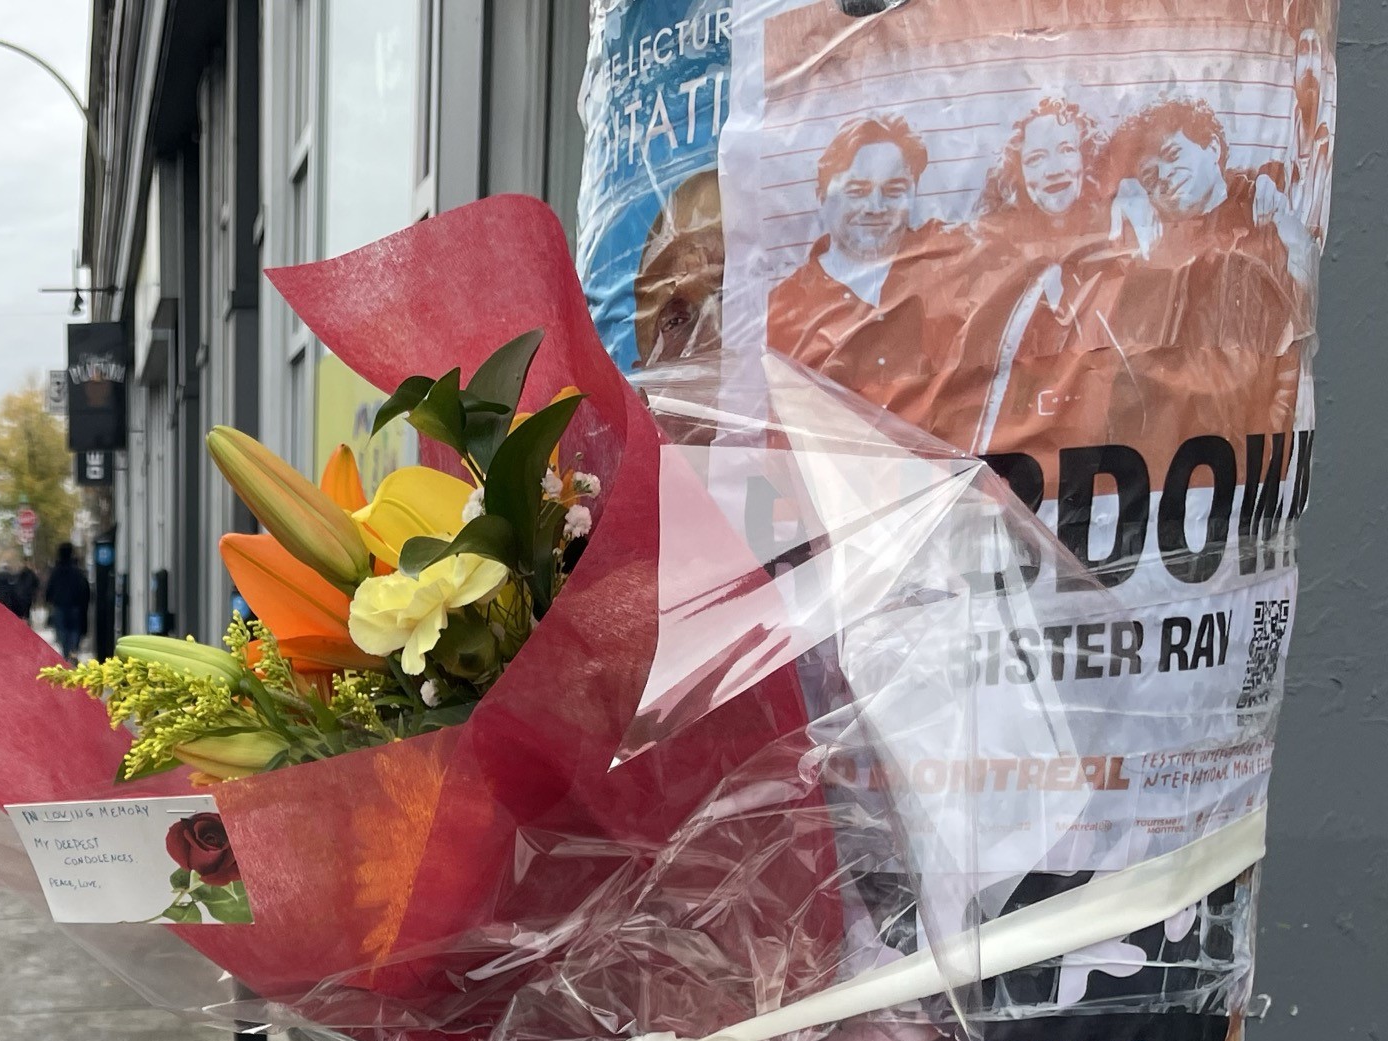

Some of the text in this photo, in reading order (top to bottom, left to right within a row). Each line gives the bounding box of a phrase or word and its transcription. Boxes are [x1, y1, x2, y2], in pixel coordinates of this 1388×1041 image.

[628, 7, 733, 78] LECTUR
[965, 608, 1233, 687] SISTER RAY
[22, 811, 39, 825] IN
[99, 805, 151, 818] MEMORY
[34, 837, 100, 849] MY DEEPEST
